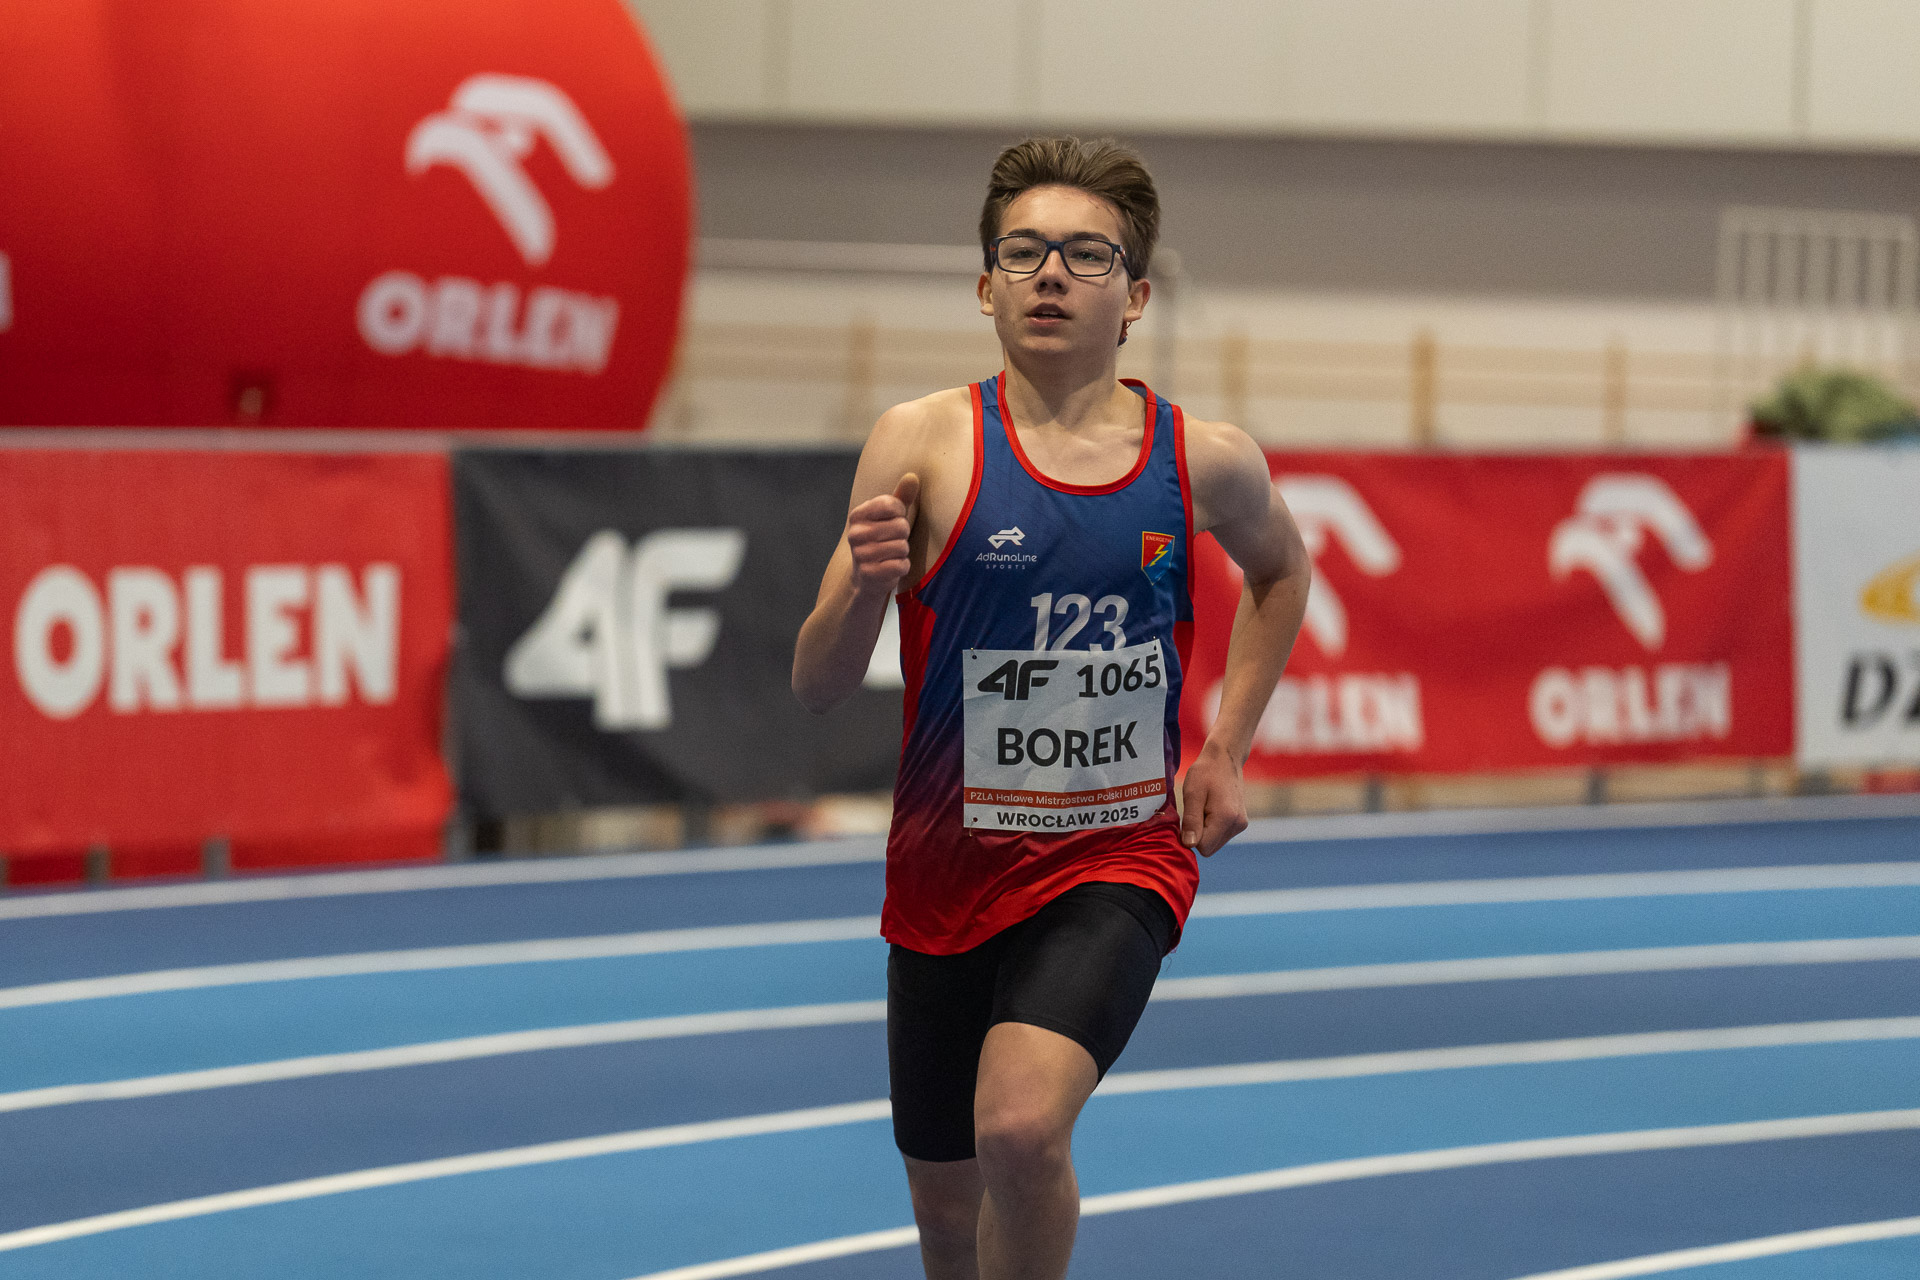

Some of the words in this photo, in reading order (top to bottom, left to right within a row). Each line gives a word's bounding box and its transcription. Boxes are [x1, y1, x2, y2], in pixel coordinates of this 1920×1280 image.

[357, 271, 618, 374] ORLEN
[13, 562, 400, 720] ORLEN
[503, 528, 746, 731] 4F
[1030, 592, 1130, 652] 123
[977, 659, 1060, 701] 4F
[1076, 653, 1161, 698] 1065
[1529, 662, 1732, 750] ORLEN
[997, 720, 1138, 769] BOREK
[970, 791, 994, 801] PZLA
[996, 793, 1034, 804] Halowe
[1036, 794, 1095, 805] Mistrzostwa
[1097, 789, 1123, 801] Polski
[1124, 786, 1138, 798] U18
[1144, 782, 1162, 794] U20
[996, 811, 1096, 828] WROCŁAW
[1100, 805, 1139, 824] 2025
